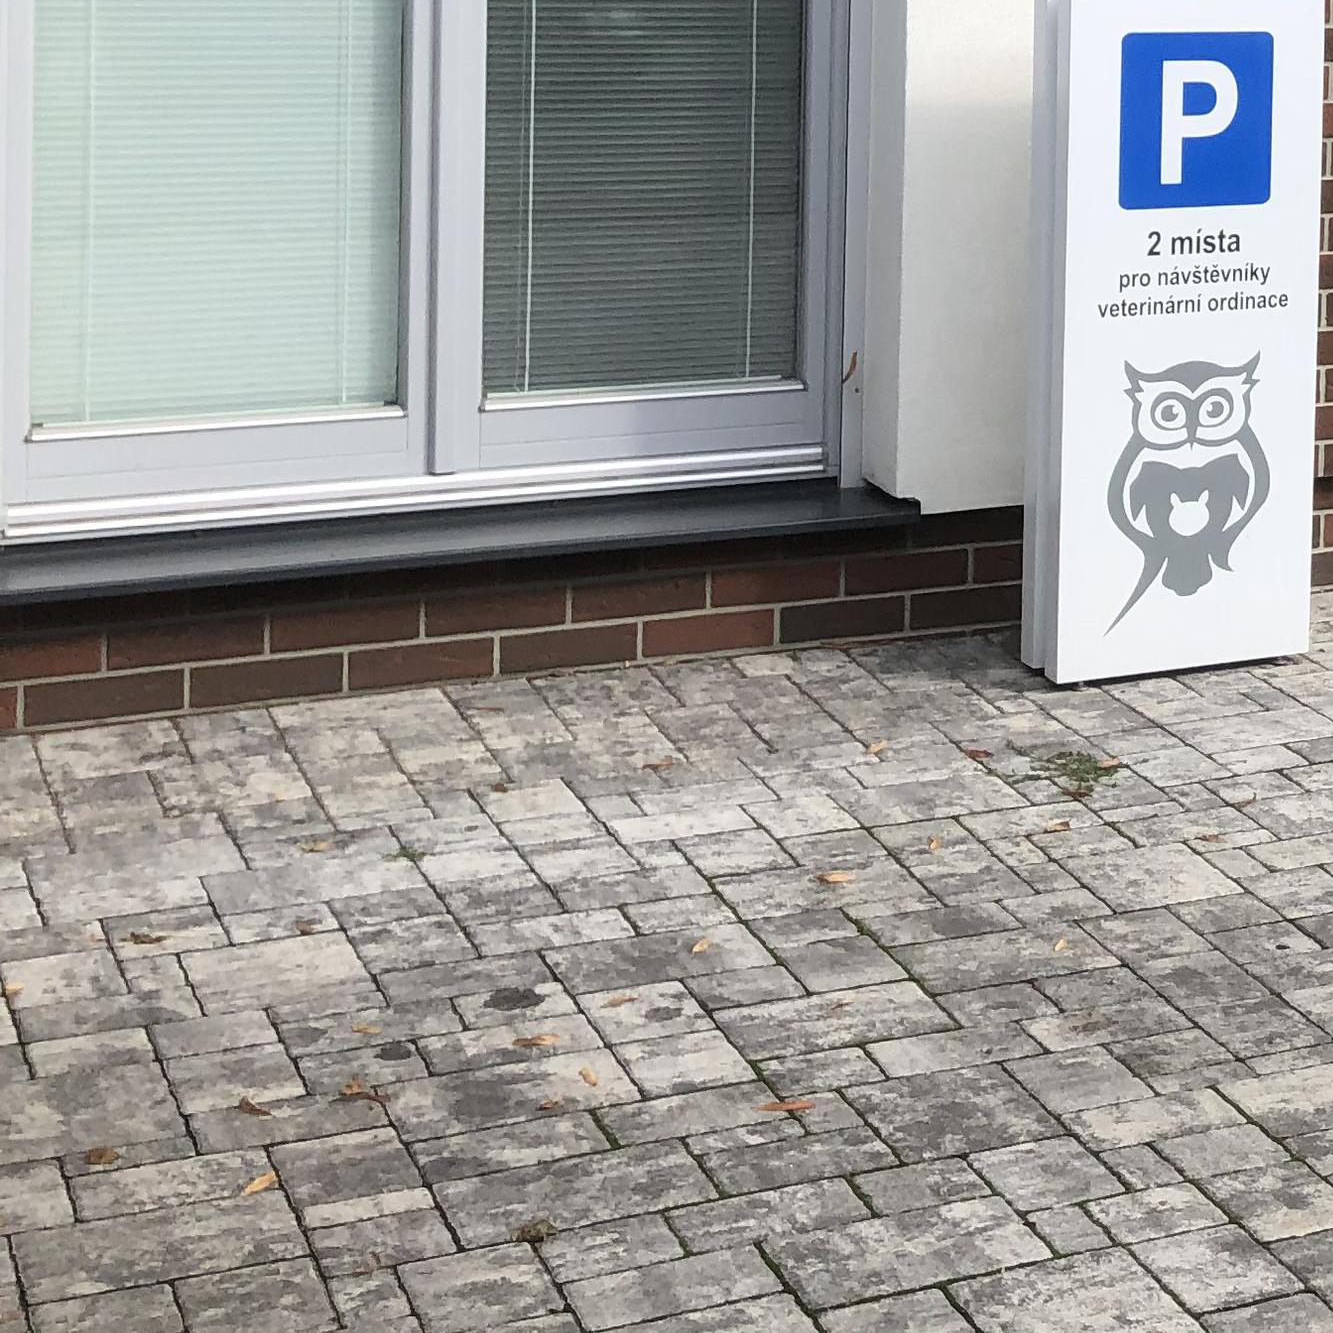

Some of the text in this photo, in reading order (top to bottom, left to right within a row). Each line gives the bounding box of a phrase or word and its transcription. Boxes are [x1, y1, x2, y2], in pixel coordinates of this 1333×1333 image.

[1160, 60, 1239, 185] P
[1147, 228, 1241, 256] 2 místa
[1119, 262, 1271, 293] pro návštěvníky
[1098, 292, 1289, 318] veterinární ordinace
